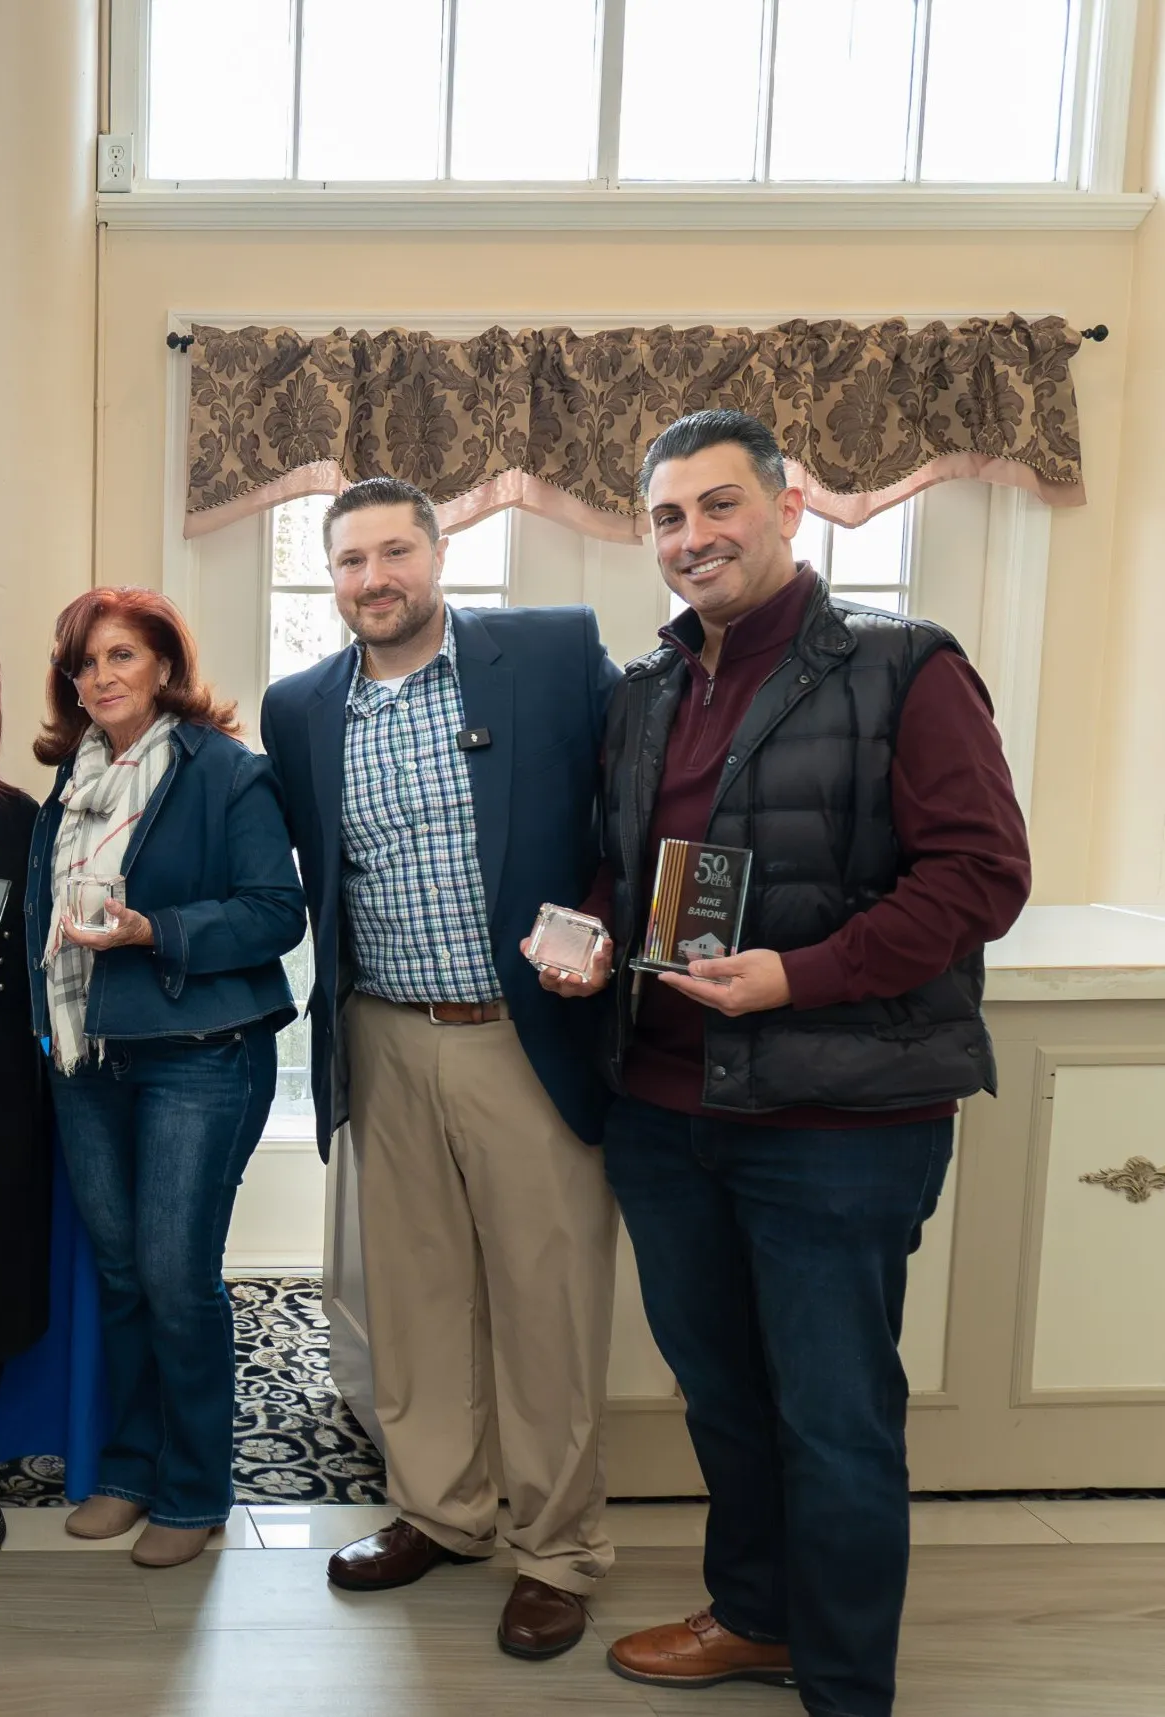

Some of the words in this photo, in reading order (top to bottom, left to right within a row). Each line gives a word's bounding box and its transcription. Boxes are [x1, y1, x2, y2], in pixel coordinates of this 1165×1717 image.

[694, 852, 729, 884] 50
[697, 896, 722, 907] MIKE
[687, 906, 728, 920] BARONE
